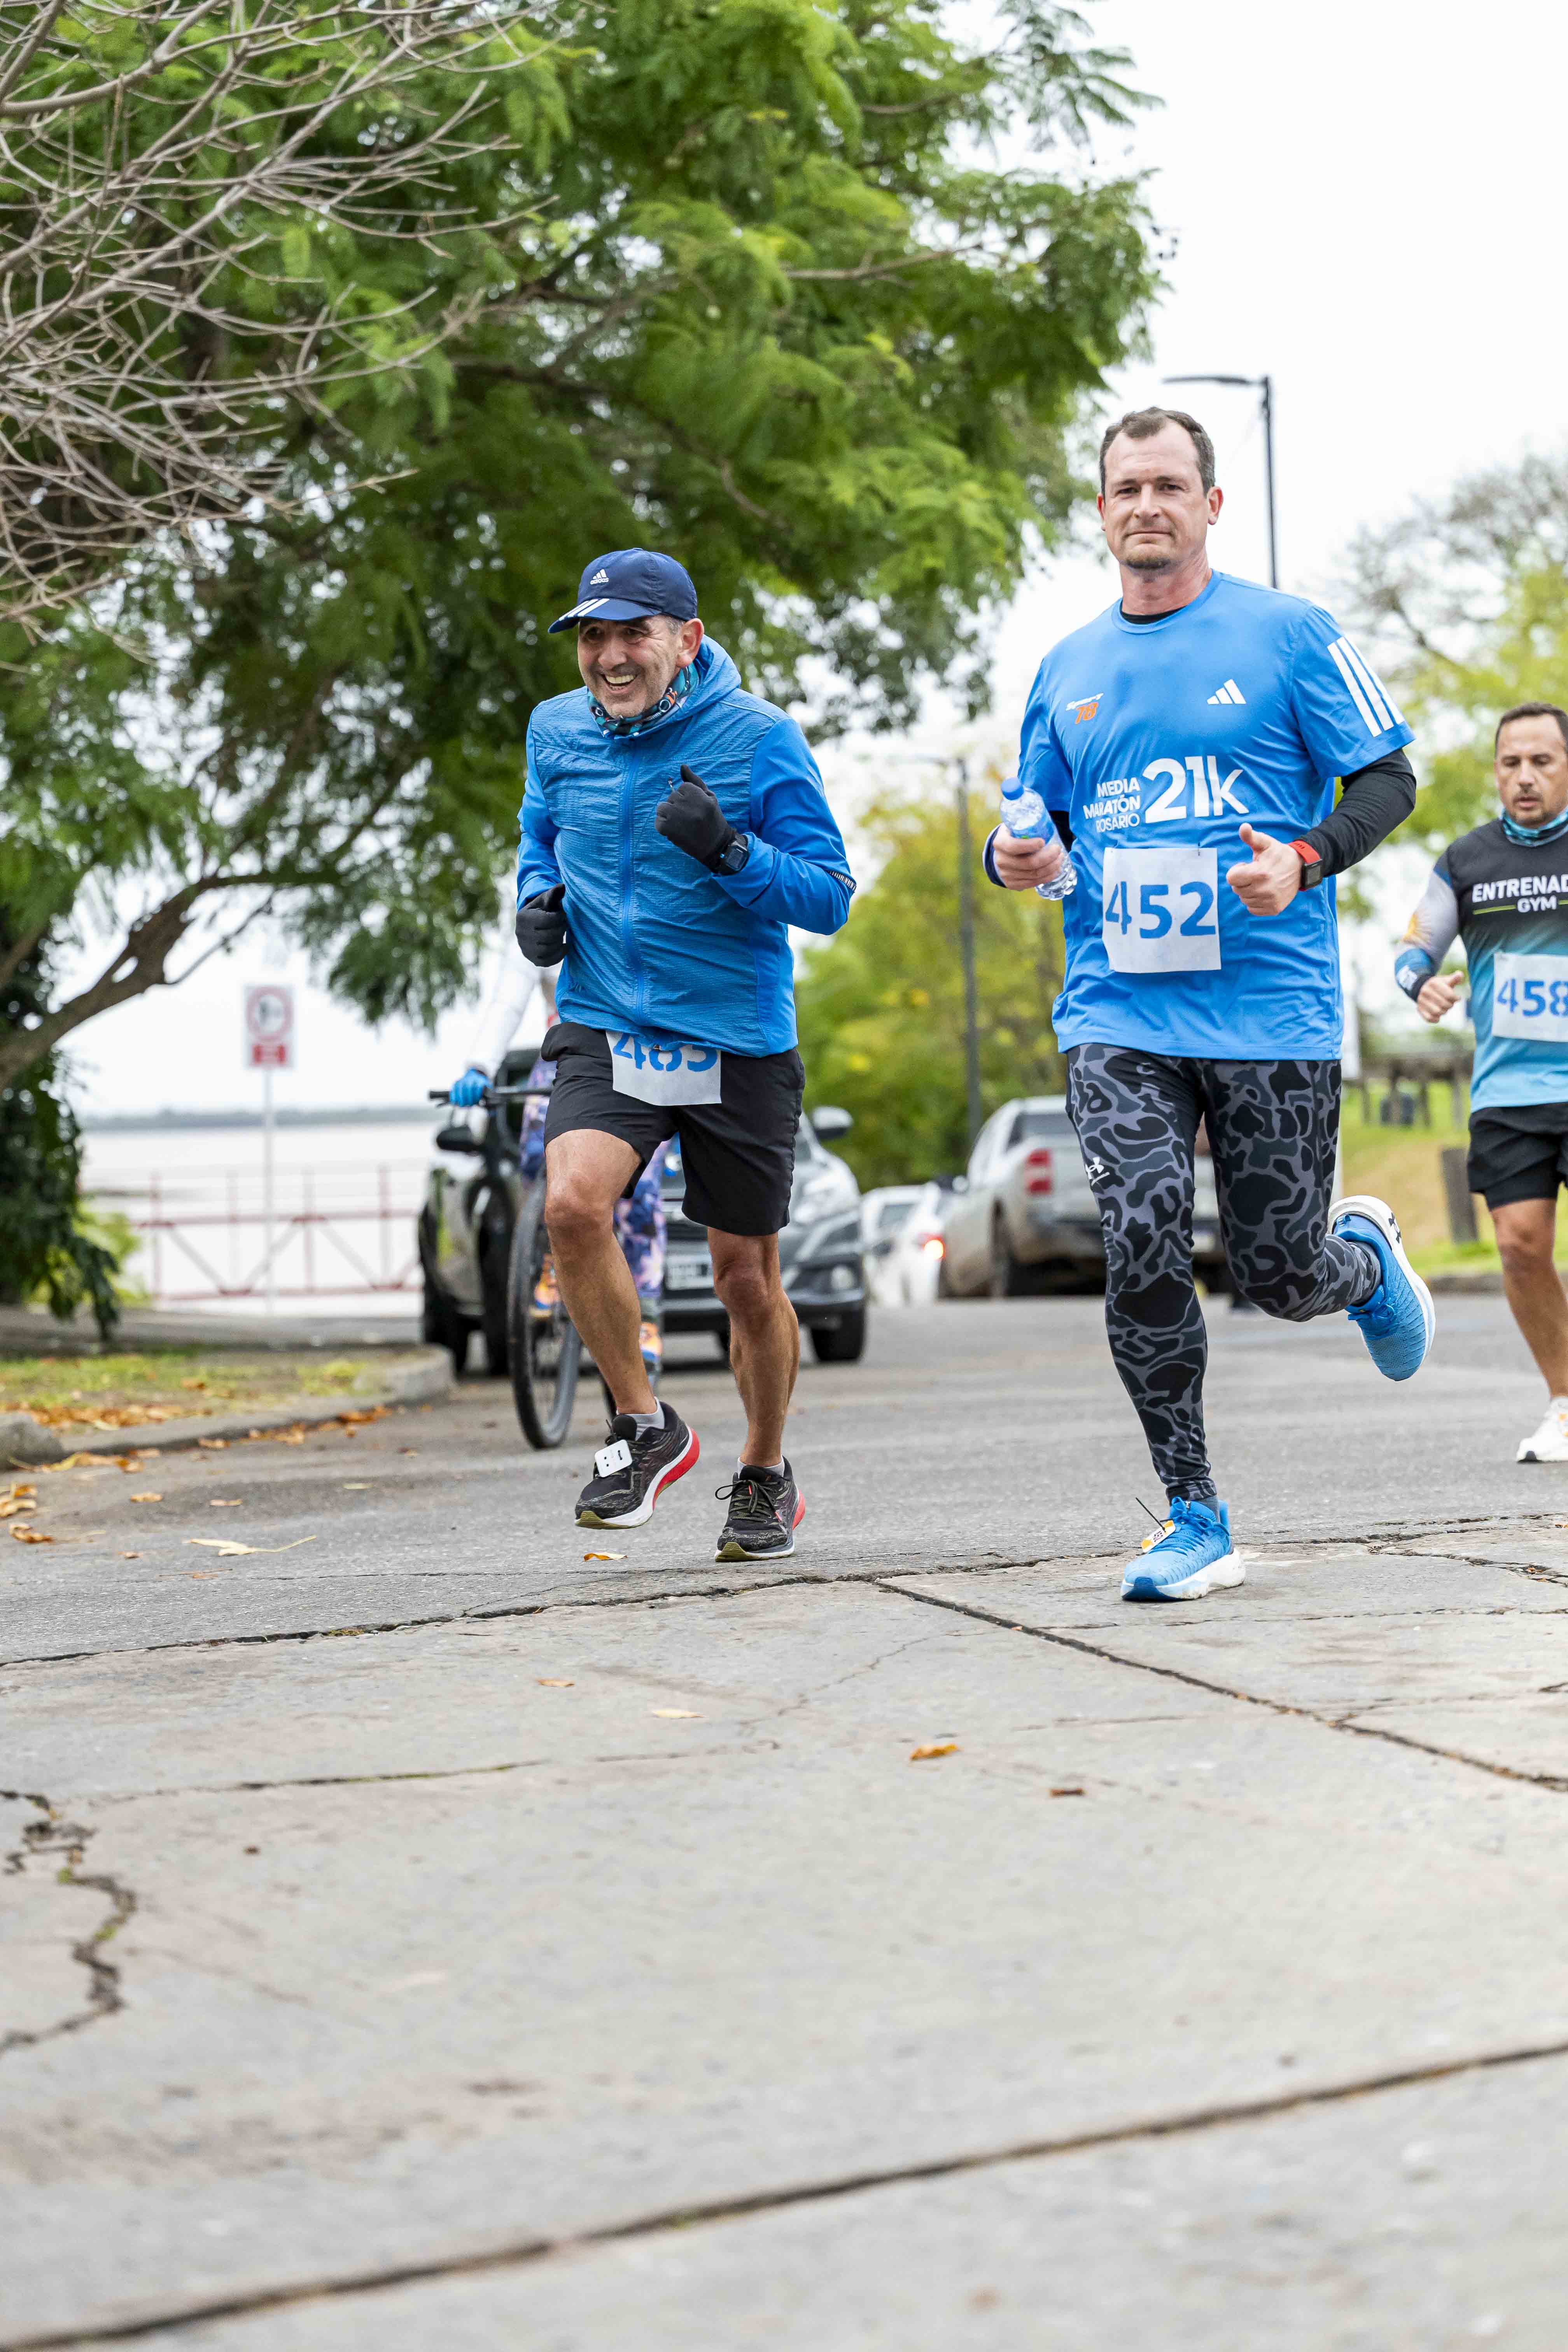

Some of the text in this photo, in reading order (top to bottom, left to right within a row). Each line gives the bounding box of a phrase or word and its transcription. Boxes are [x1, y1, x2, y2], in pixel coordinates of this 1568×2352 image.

[1074, 702, 1099, 724] 78
[1097, 777, 1141, 798] MEDIA
[1083, 794, 1141, 820] MARATÓN
[1096, 813, 1140, 833] ROSARIO
[1105, 880, 1216, 939] 452
[1517, 895, 1557, 913] GYM
[1496, 977, 1568, 1018] 458
